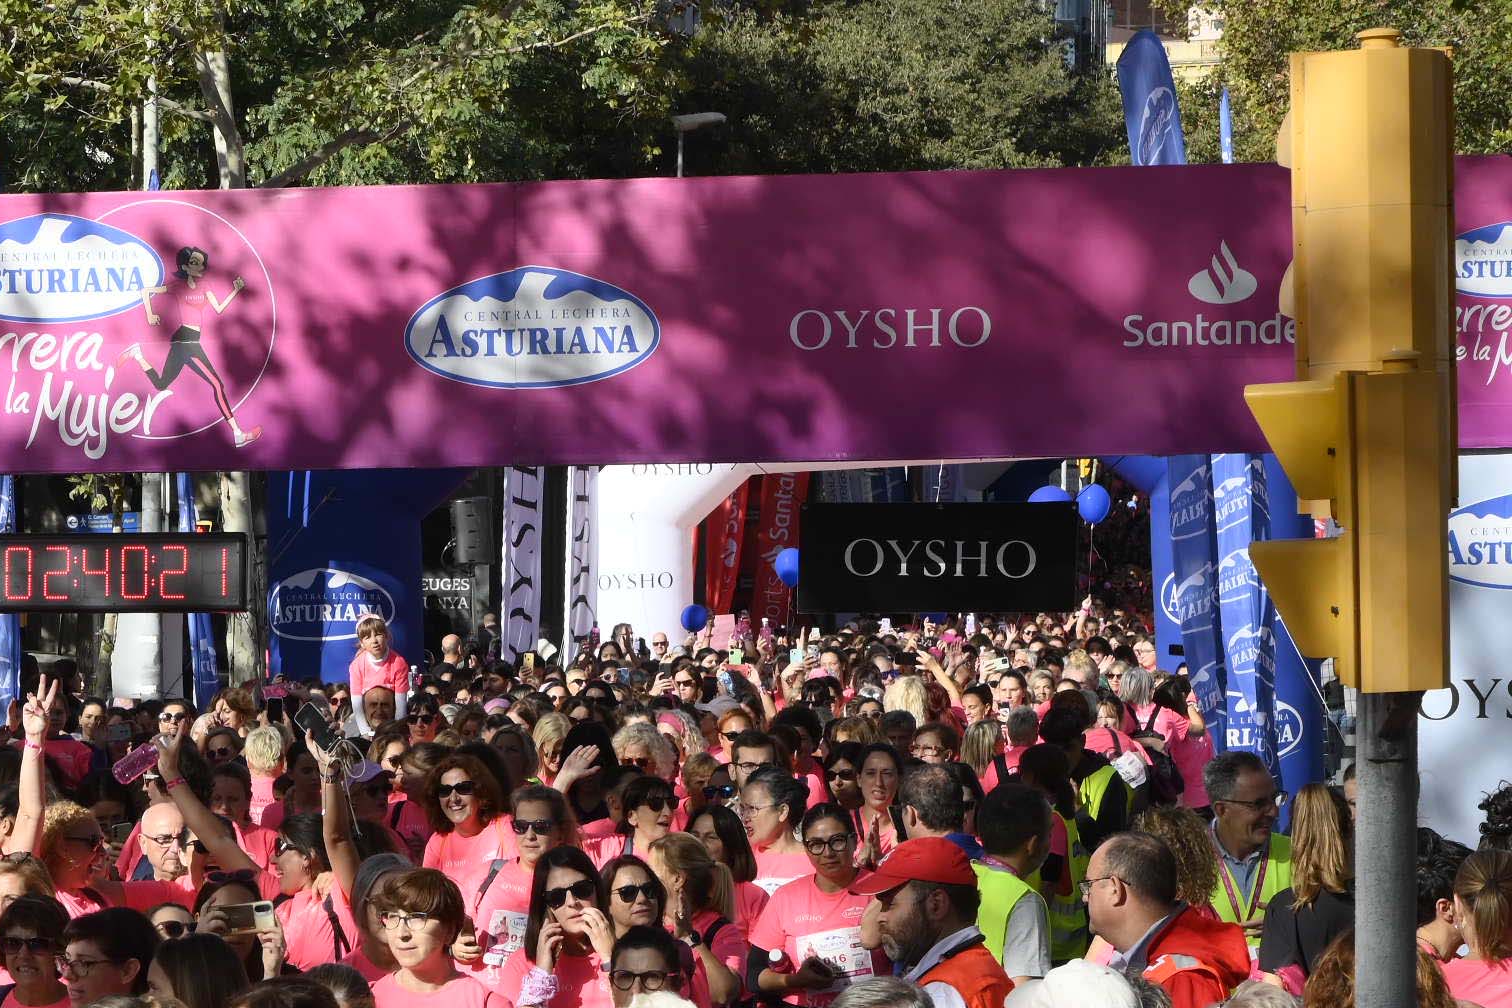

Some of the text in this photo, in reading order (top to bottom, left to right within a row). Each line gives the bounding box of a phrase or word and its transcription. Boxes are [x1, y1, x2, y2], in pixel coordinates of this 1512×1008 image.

[424, 314, 639, 358] ASTURIANA
[464, 308, 632, 321] CENTRAL LECHERA
[789, 306, 991, 351] OYSHO
[1123, 313, 1295, 347] Santande
[5, 373, 30, 413] la
[26, 365, 172, 459] Mujer
[4, 546, 228, 599] 02:40:21
[845, 537, 1037, 579] OYSHO
[598, 572, 674, 591] OYSHO
